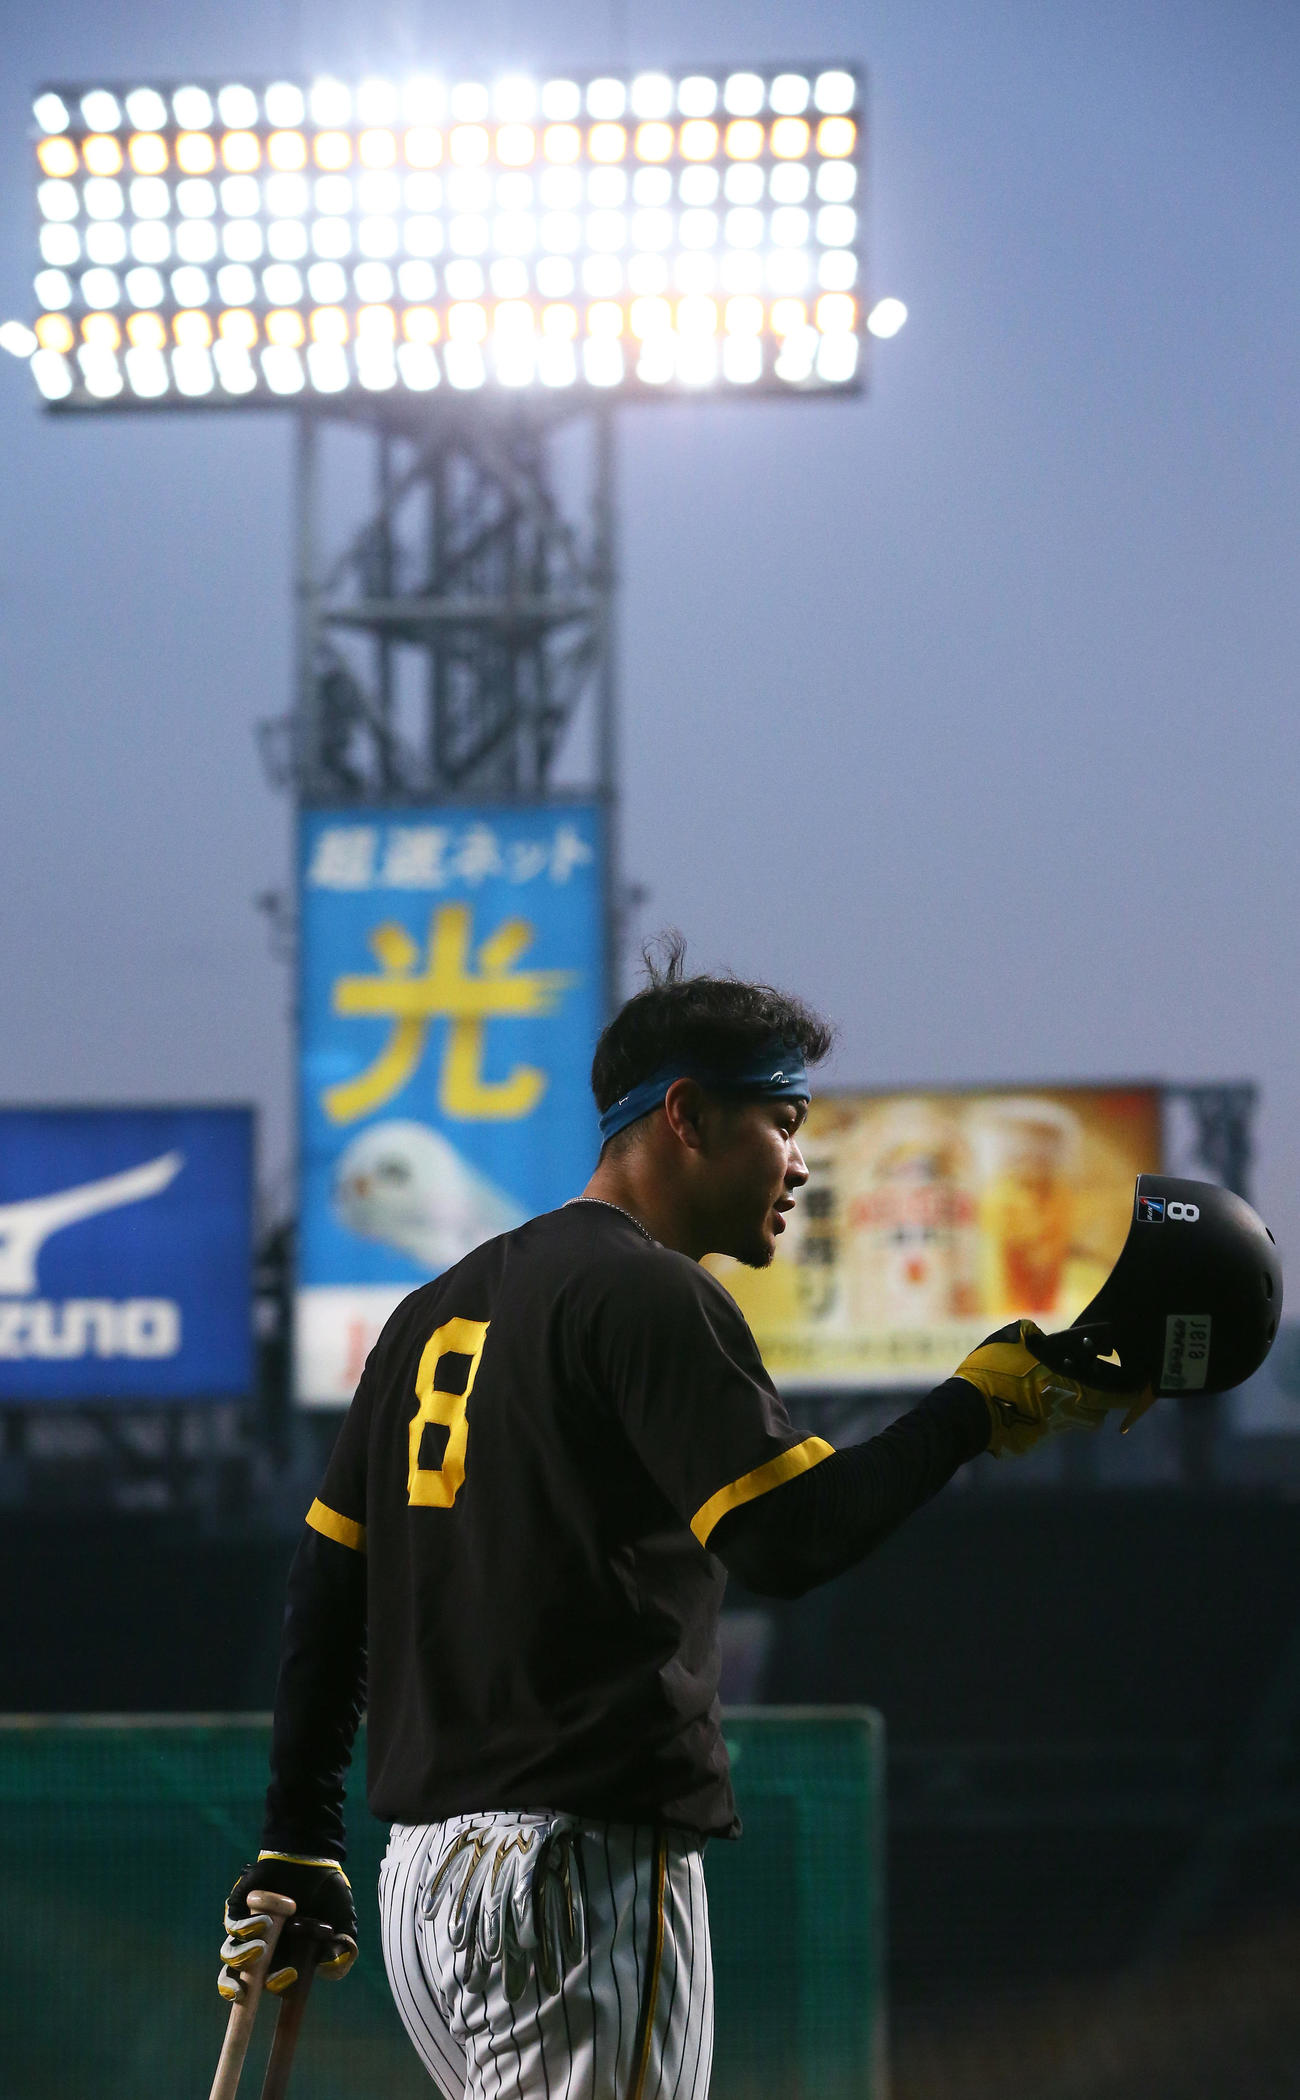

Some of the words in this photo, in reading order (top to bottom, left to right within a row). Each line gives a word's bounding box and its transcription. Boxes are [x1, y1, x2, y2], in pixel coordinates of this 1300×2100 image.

[322, 902, 575, 1122] 光
[1167, 1201, 1200, 1223] 8
[407, 1316, 491, 1508] 8
